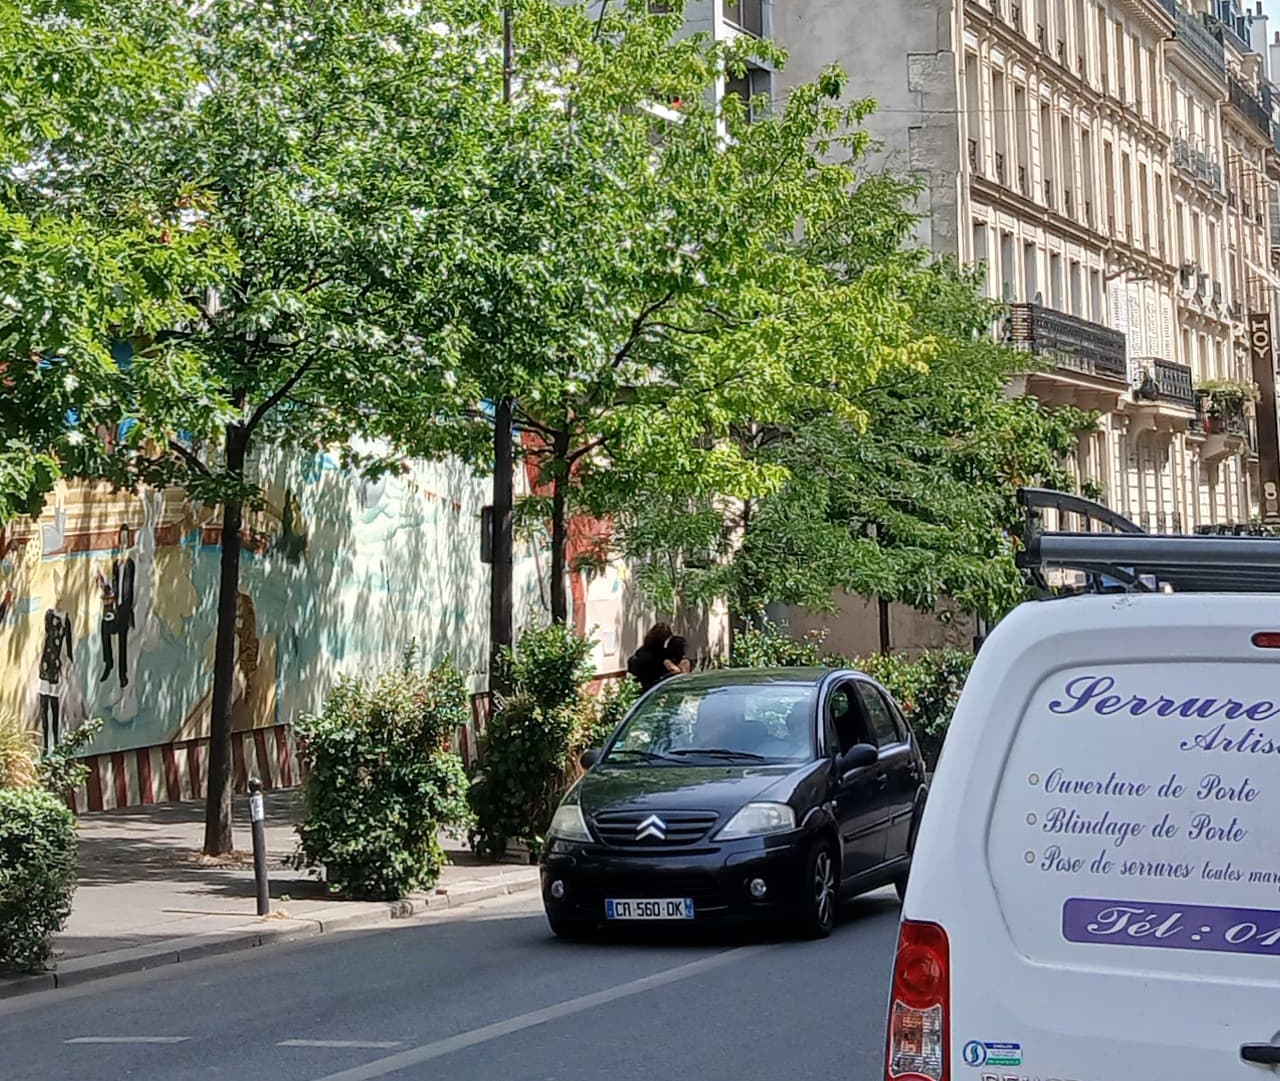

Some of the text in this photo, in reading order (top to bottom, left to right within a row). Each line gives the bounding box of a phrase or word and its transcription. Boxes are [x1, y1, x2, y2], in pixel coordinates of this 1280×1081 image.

[1251, 319, 1270, 358] HOY
[1044, 768, 1261, 802] Ouverture de Porte
[1042, 807, 1249, 847] Blindage de Porte
[1040, 845, 1085, 873] Pose
[1090, 849, 1116, 874] de
[1119, 857, 1195, 880] serrures
[1201, 861, 1244, 883] toutes
[1086, 906, 1185, 939] Tél
